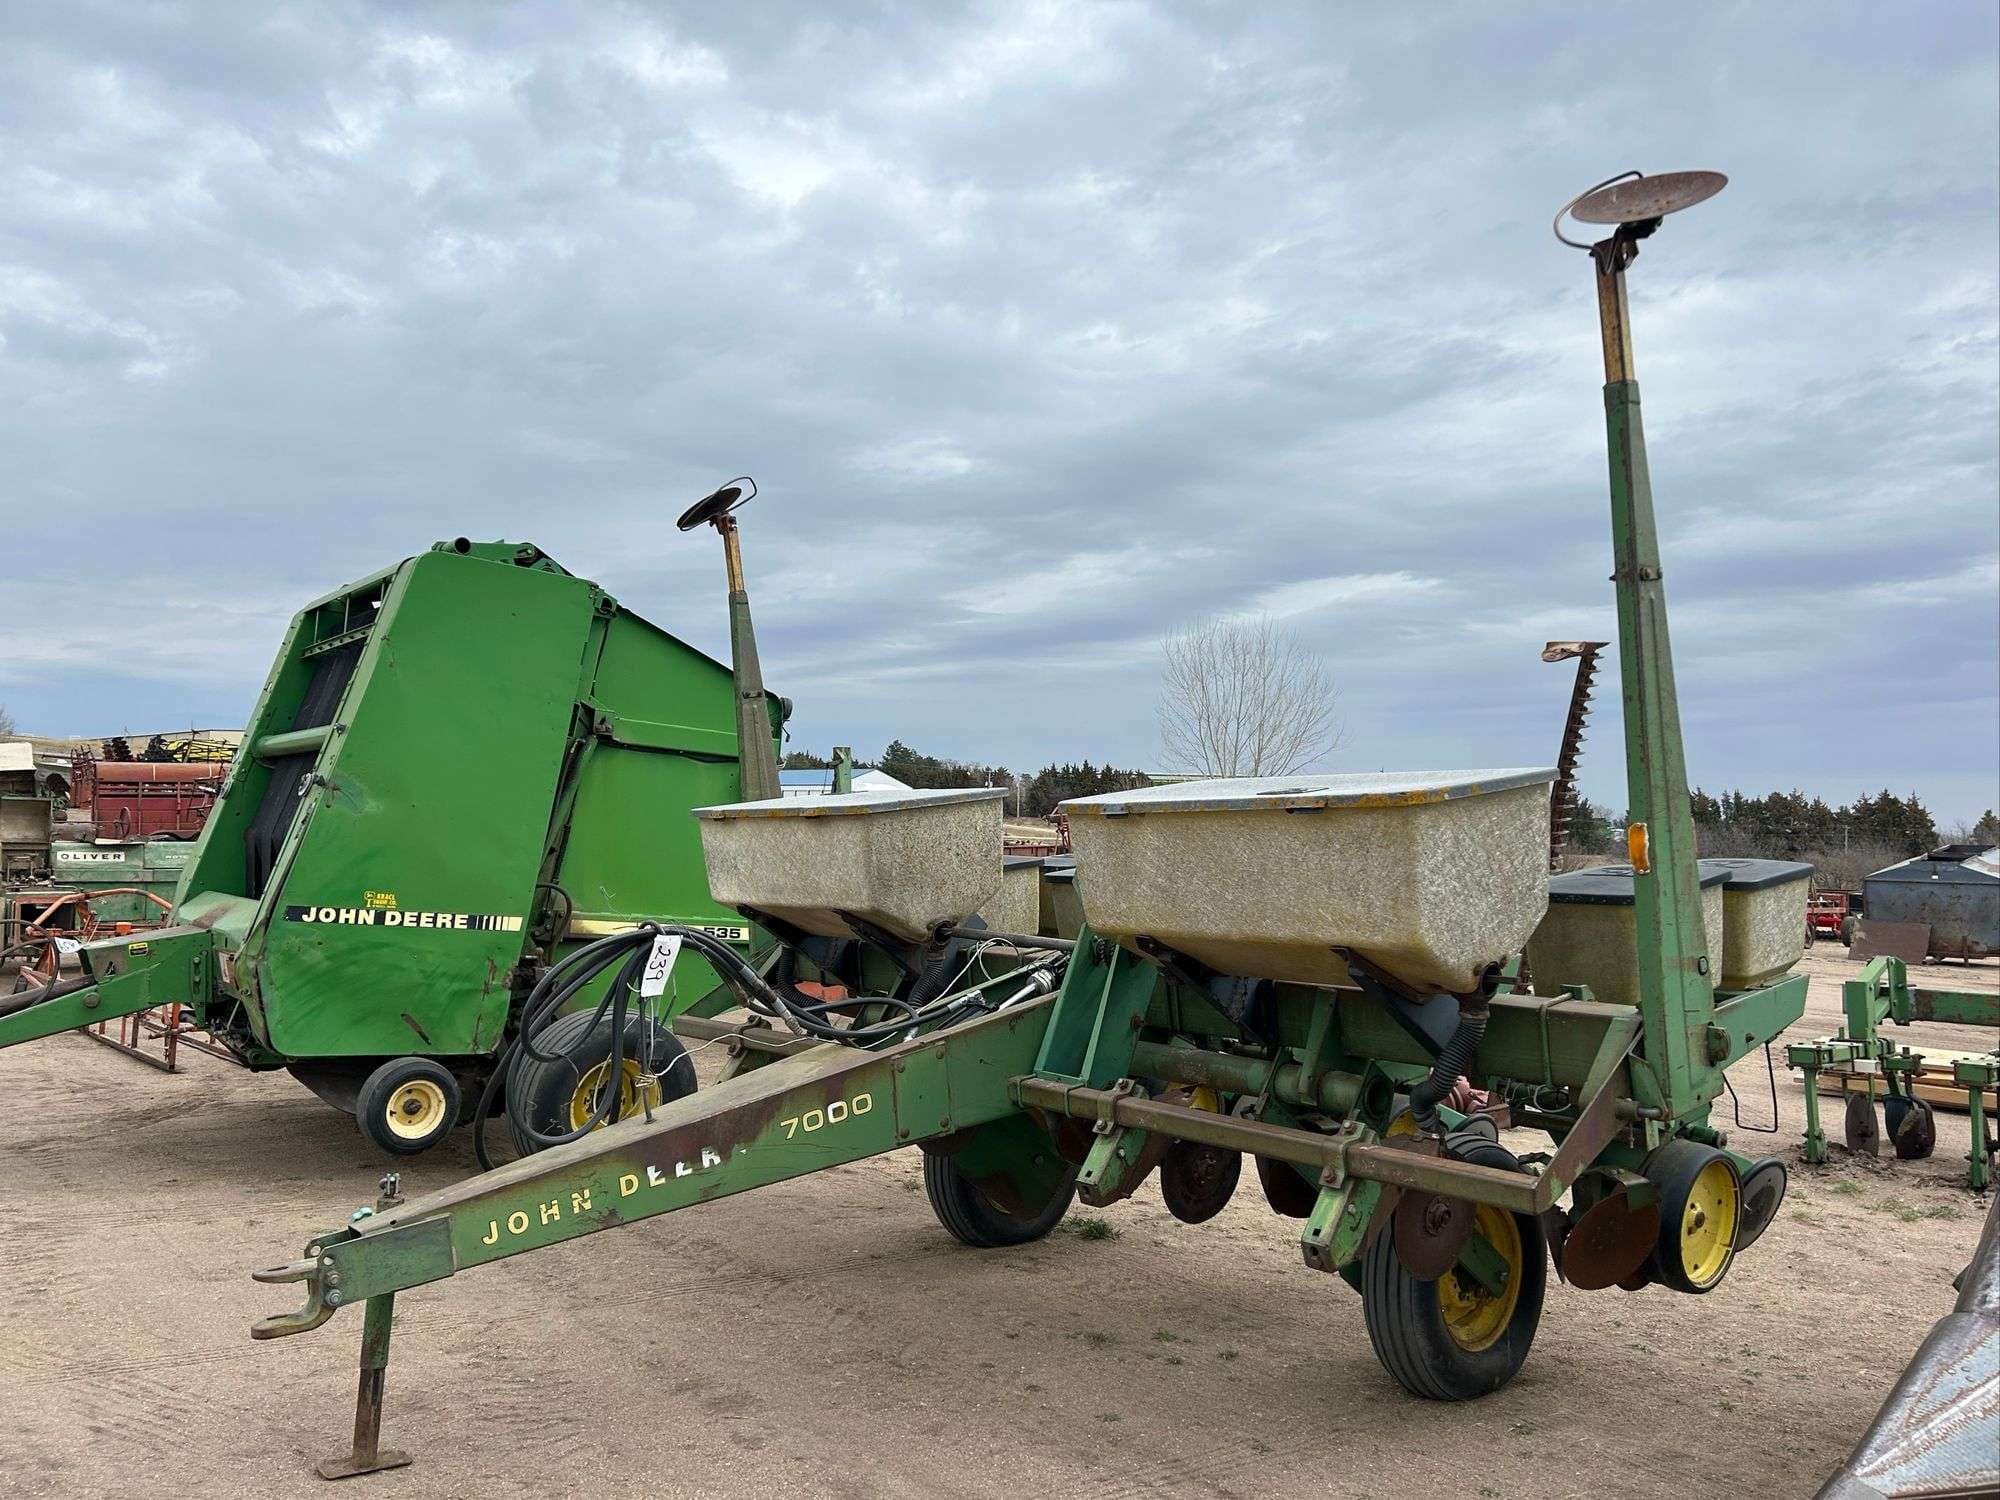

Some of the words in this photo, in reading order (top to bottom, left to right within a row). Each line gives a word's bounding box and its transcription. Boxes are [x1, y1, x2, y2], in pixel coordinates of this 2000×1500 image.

[301, 906, 376, 926] JOHN
[384, 911, 469, 930] DEERE
[703, 927, 742, 940] 535
[645, 945, 672, 981] 239
[779, 1092, 873, 1141] 7000
[482, 1188, 593, 1246] JOHN
